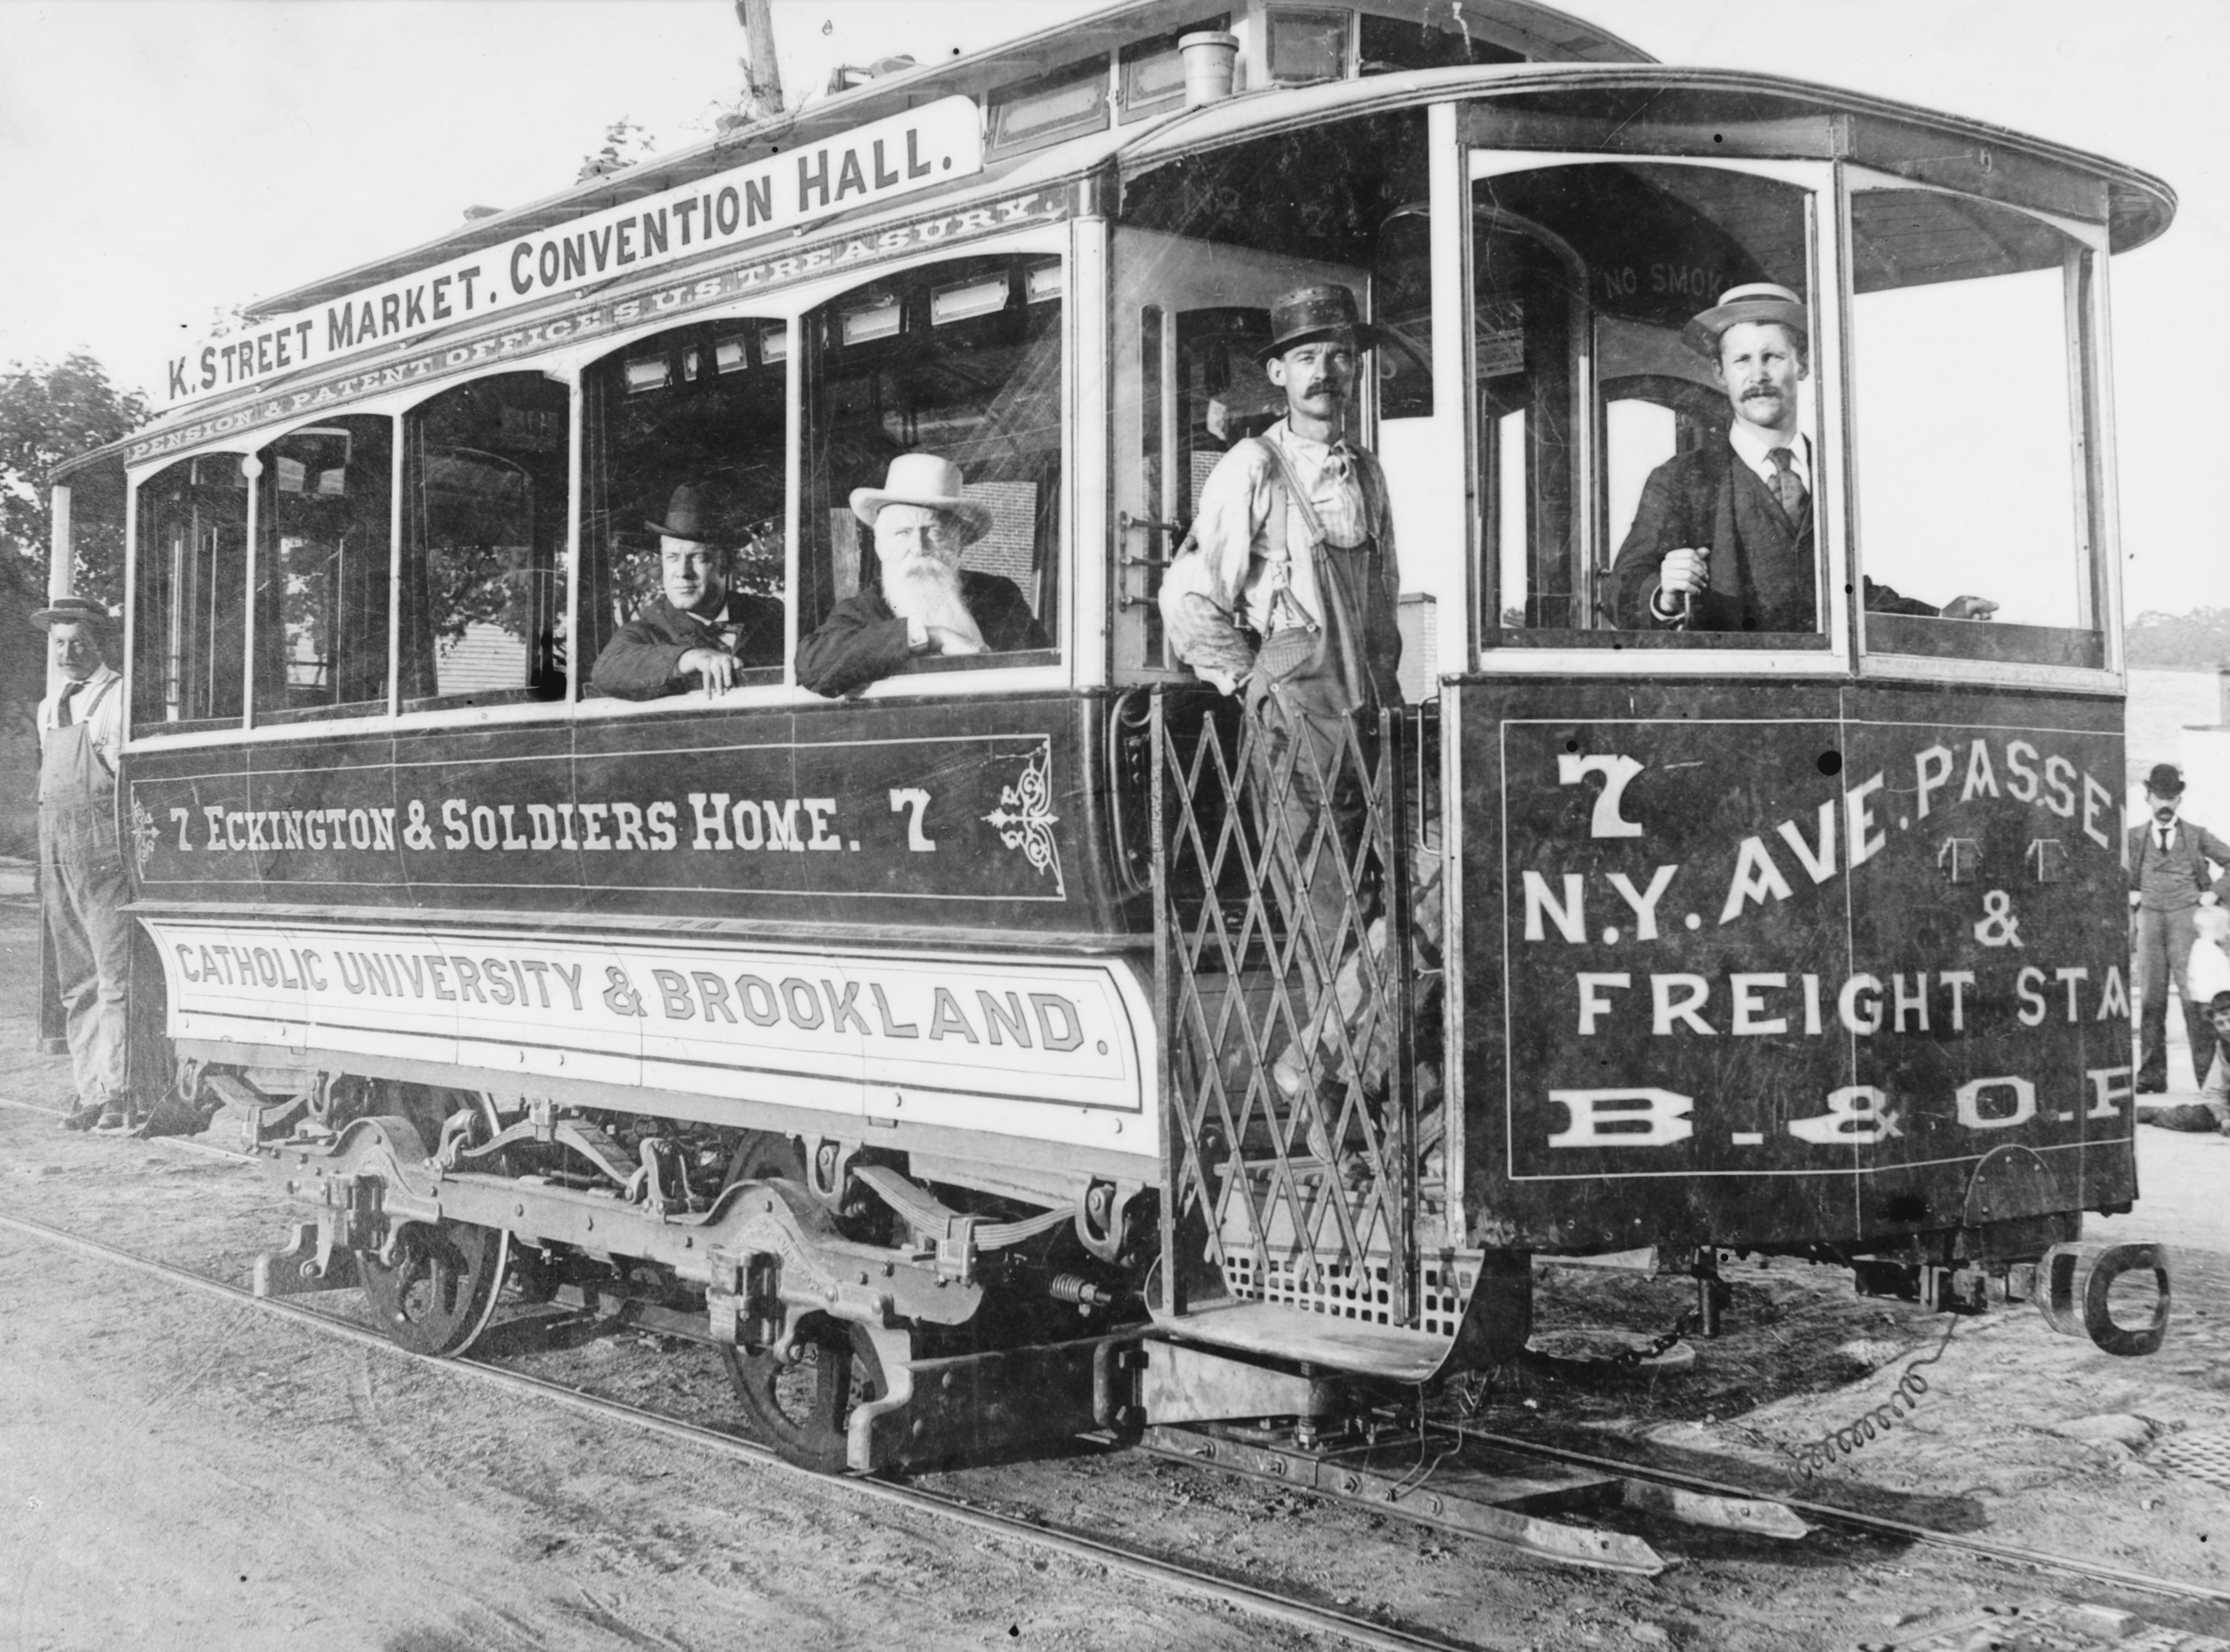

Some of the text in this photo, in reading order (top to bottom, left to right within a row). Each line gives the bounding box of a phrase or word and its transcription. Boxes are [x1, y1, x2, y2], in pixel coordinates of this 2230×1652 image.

[200, 319, 313, 390] STREET
[327, 265, 497, 352] MARKET.
[510, 175, 772, 295] CONVENTION
[798, 128, 952, 212] HALL.
[1604, 263, 1735, 299] NO SMOK
[132, 409, 255, 458] PENSION
[264, 401, 282, 416] &
[292, 358, 433, 410] PATENT
[738, 193, 1053, 287] TREASURY.
[170, 788, 936, 852] 7 ECKINGTON & SOLDIERS HOME. 7
[1558, 754, 1646, 838] 7
[1915, 739, 2130, 871] PASSE
[1973, 889, 2024, 947] &
[176, 943, 1109, 1056] CATHOLIC UNIVERSITY & BROOKLAND.
[1575, 970, 1975, 1037] FREIGHT
